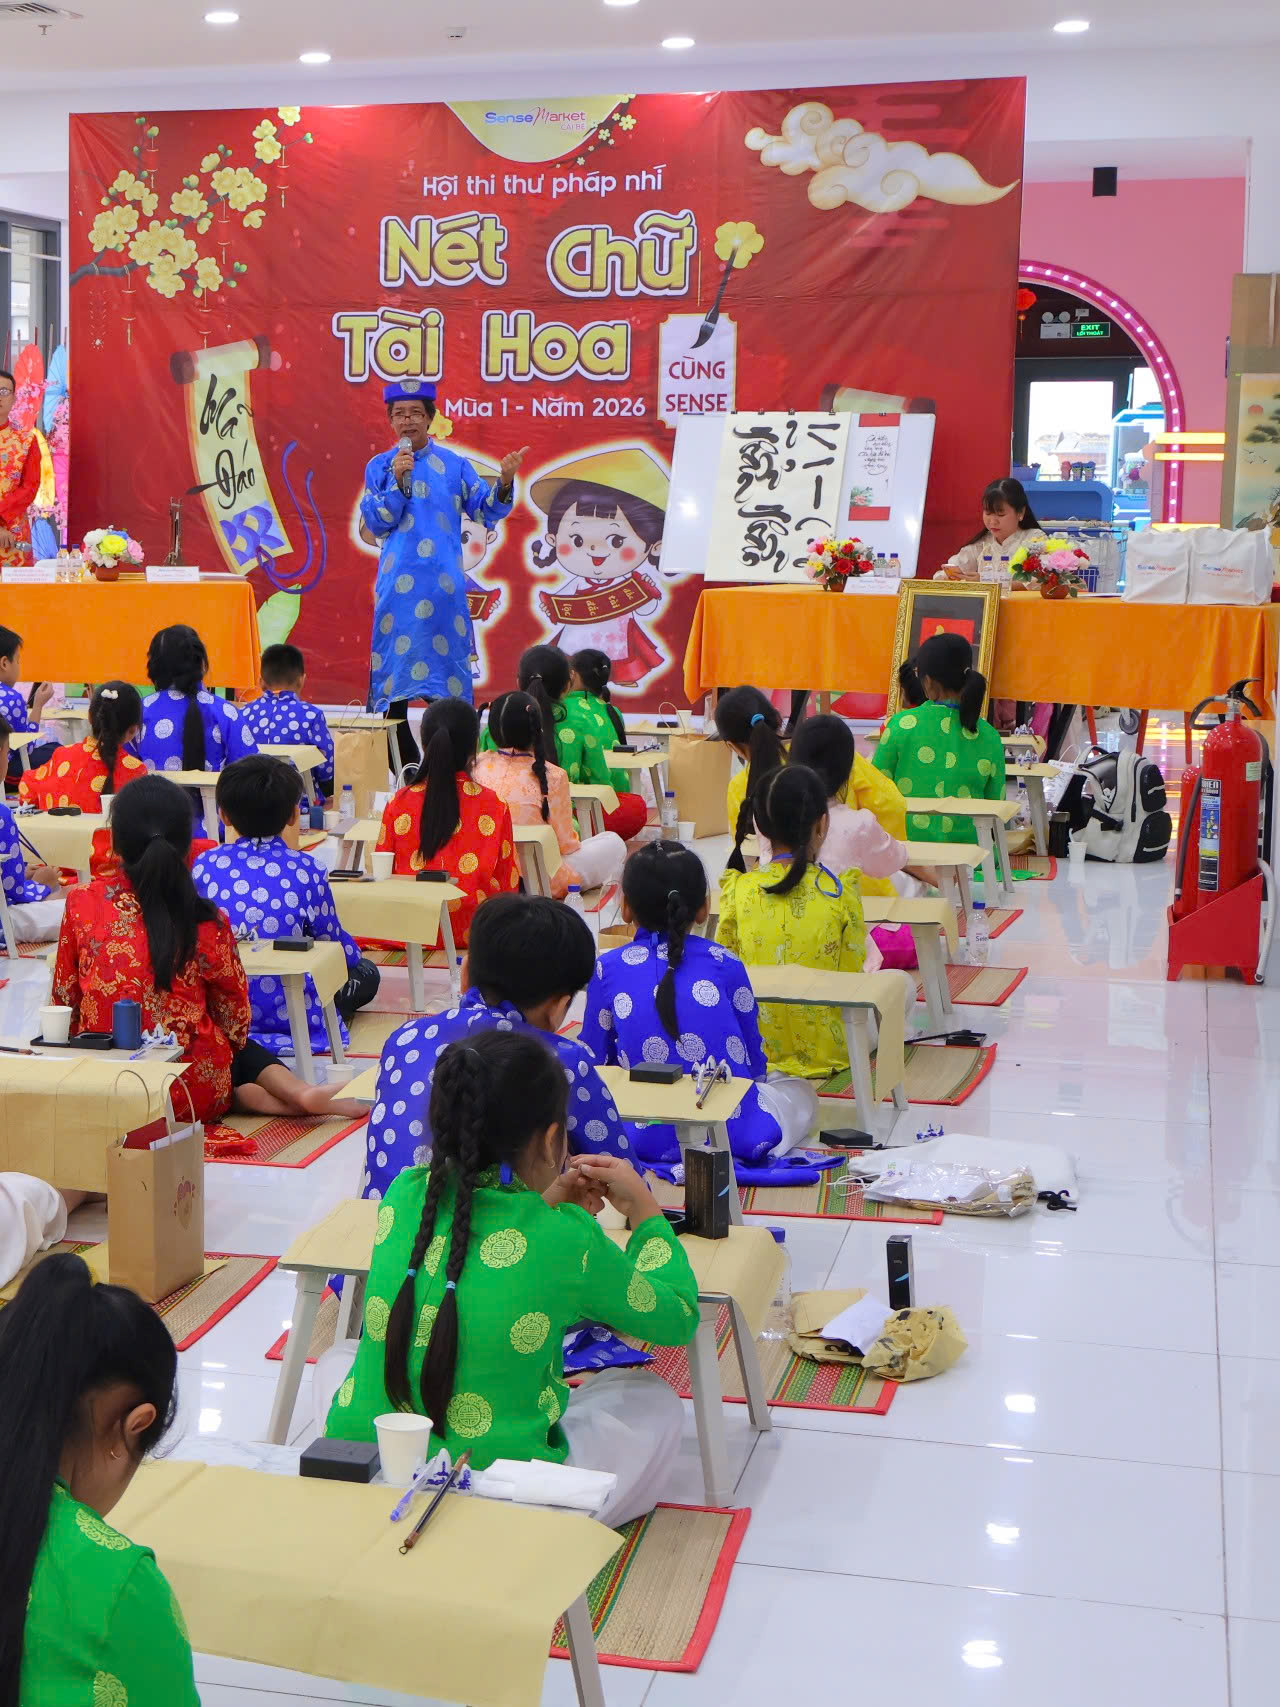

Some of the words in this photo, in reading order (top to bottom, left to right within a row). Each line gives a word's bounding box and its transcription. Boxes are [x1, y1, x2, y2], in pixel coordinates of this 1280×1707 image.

[423, 175, 458, 200] Hội
[466, 174, 496, 195] thi
[504, 173, 545, 195] thư
[552, 171, 617, 198] pháp
[625, 164, 667, 191] nhí
[381, 212, 508, 286] Nét
[548, 209, 698, 297] Chữ
[332, 307, 443, 383] Tài
[481, 310, 631, 382] Hoa
[669, 355, 725, 380] CÙNG
[444, 396, 493, 417] Mùa
[500, 397, 508, 417] 1
[532, 396, 584, 417] Năm
[592, 397, 646, 417] 2026
[665, 393, 728, 413] SENSE
